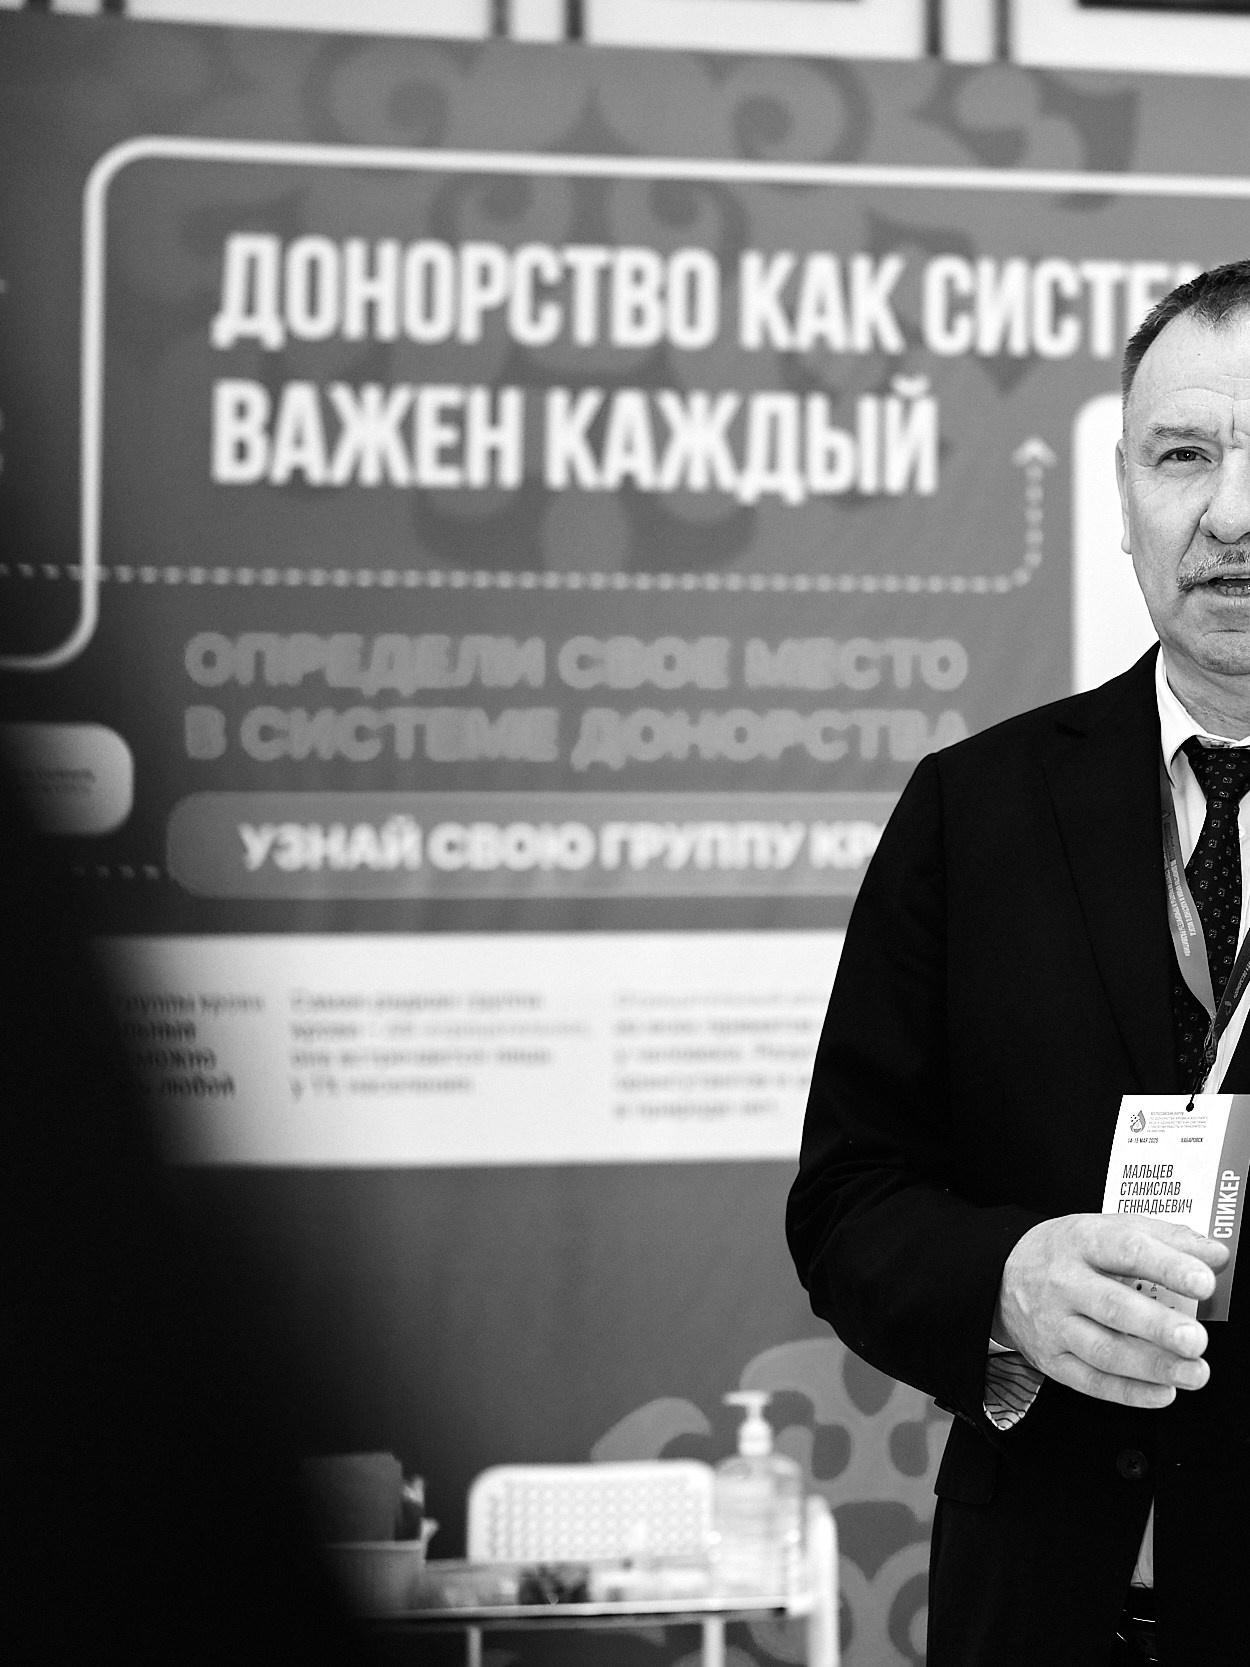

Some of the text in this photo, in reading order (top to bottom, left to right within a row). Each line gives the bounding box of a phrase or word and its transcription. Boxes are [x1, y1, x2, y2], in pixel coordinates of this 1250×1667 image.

[212, 233, 1199, 360] ДОНОРСТВО КАК СИСТЕ
[212, 372, 940, 507] ВАЖЕН КАЖДЫЙ
[185, 631, 969, 698] ОПРЕДЕЛИ СВОЕ МЕСТО
[185, 706, 227, 761] В
[240, 706, 559, 762] СИСТЕМЕ
[238, 814, 423, 872] УЗНАЙ
[428, 821, 597, 872] СВОЮ
[600, 821, 807, 872] ГРУППУ
[1120, 1182, 1181, 1196] СТАНИСЛАВ
[1122, 1165, 1174, 1179] МАЛЬЦЕВ
[1118, 1199, 1193, 1214] ГЕННАДЬЕВИЧ
[1213, 1170, 1240, 1238] СПИКЕР
